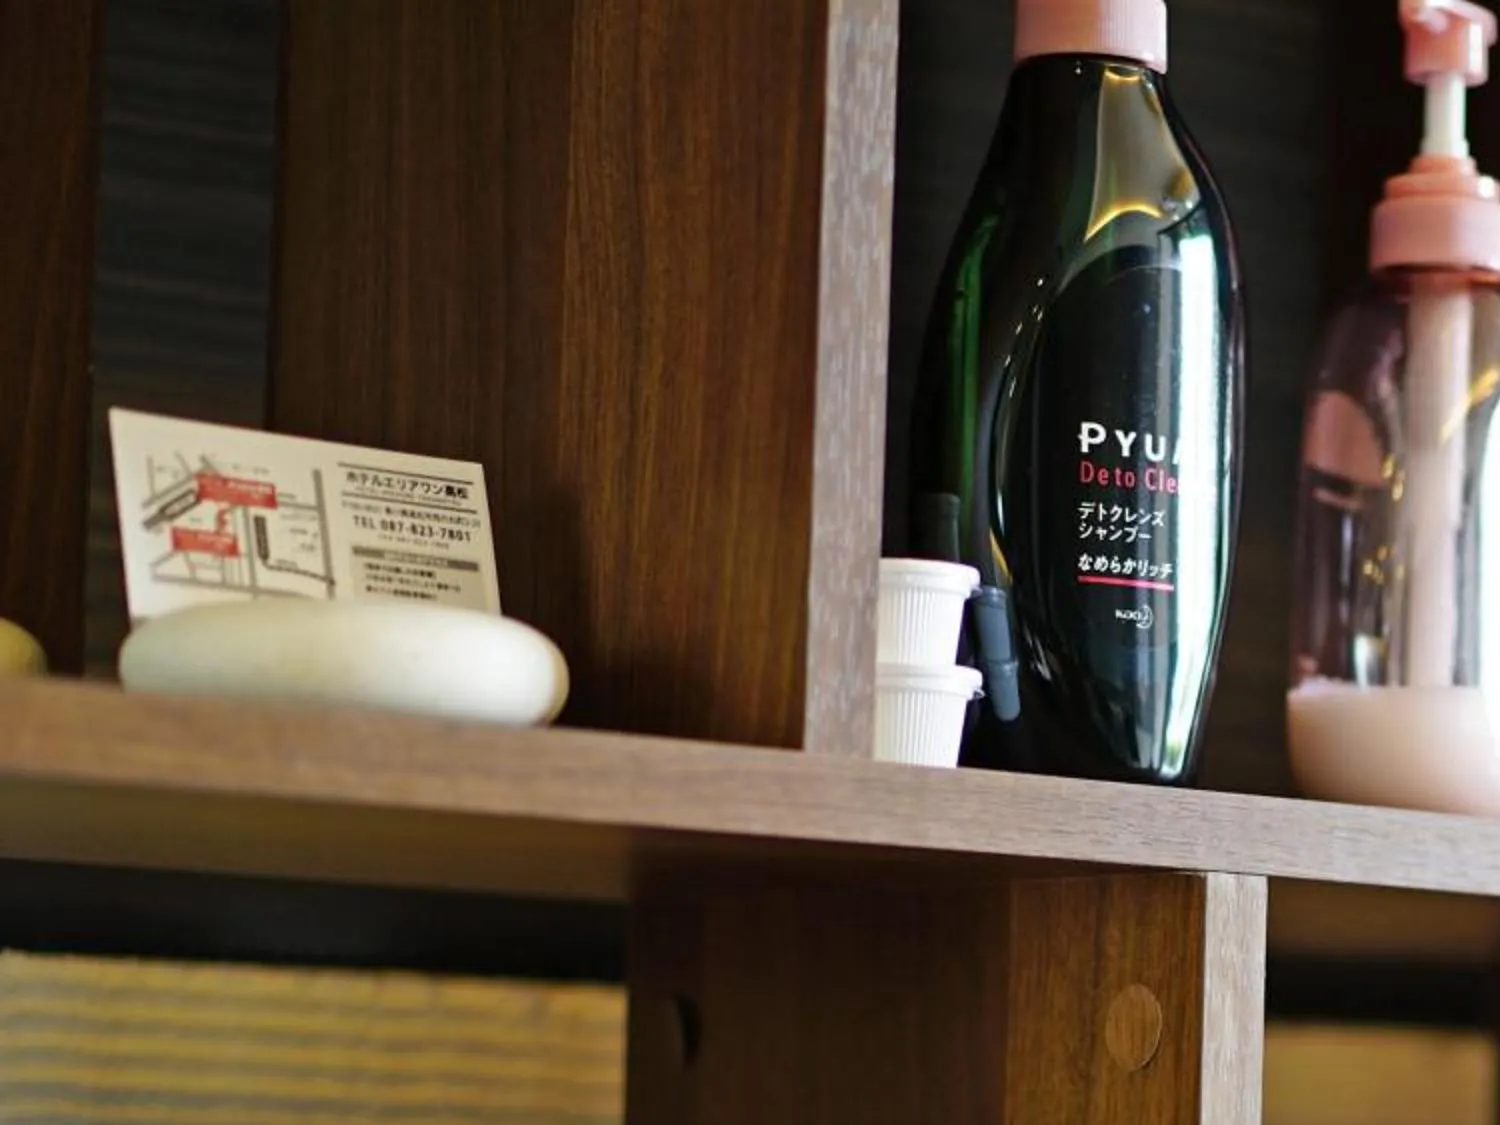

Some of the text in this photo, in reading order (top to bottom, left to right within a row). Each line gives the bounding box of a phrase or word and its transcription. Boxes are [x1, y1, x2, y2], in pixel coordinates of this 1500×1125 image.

[1079, 460, 1180, 494] Deto Cle
[353, 514, 377, 530] TEL
[1077, 501, 1166, 527] デトクレンズ
[1077, 522, 1153, 543] シャンプー
[1077, 553, 1174, 579] なめらかリッチ
